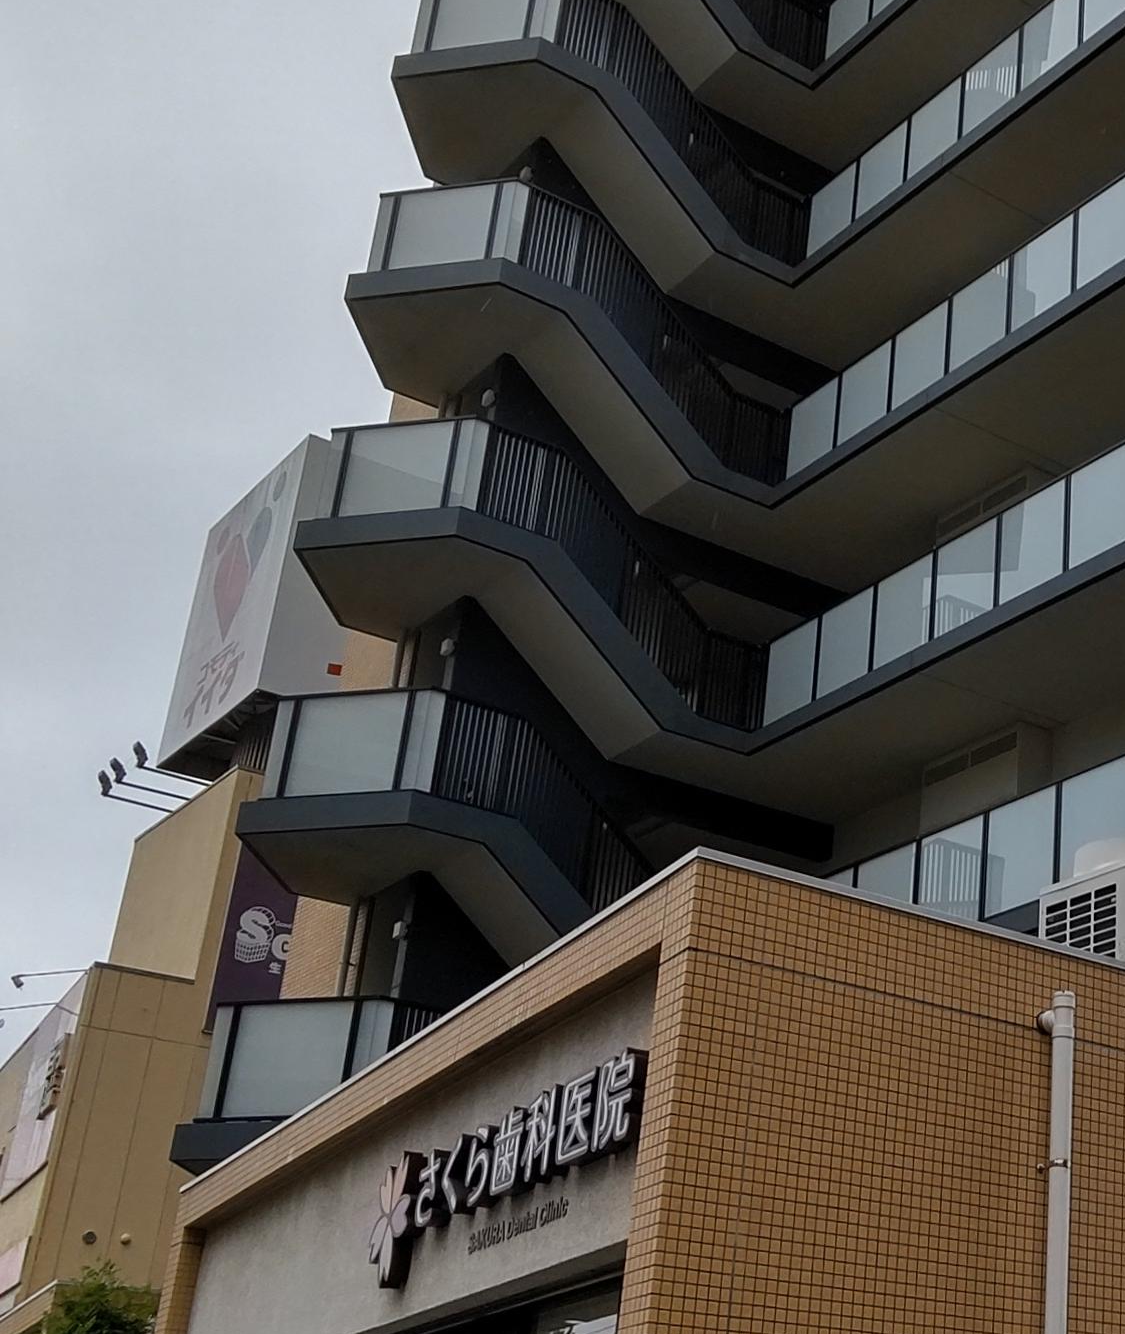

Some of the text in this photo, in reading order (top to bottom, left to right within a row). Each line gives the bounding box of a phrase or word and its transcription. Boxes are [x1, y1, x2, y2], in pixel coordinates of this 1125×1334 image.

[414, 1050, 638, 1229] さくら歯科医院
[467, 1197, 570, 1255] SAKURA Dental Clinic
